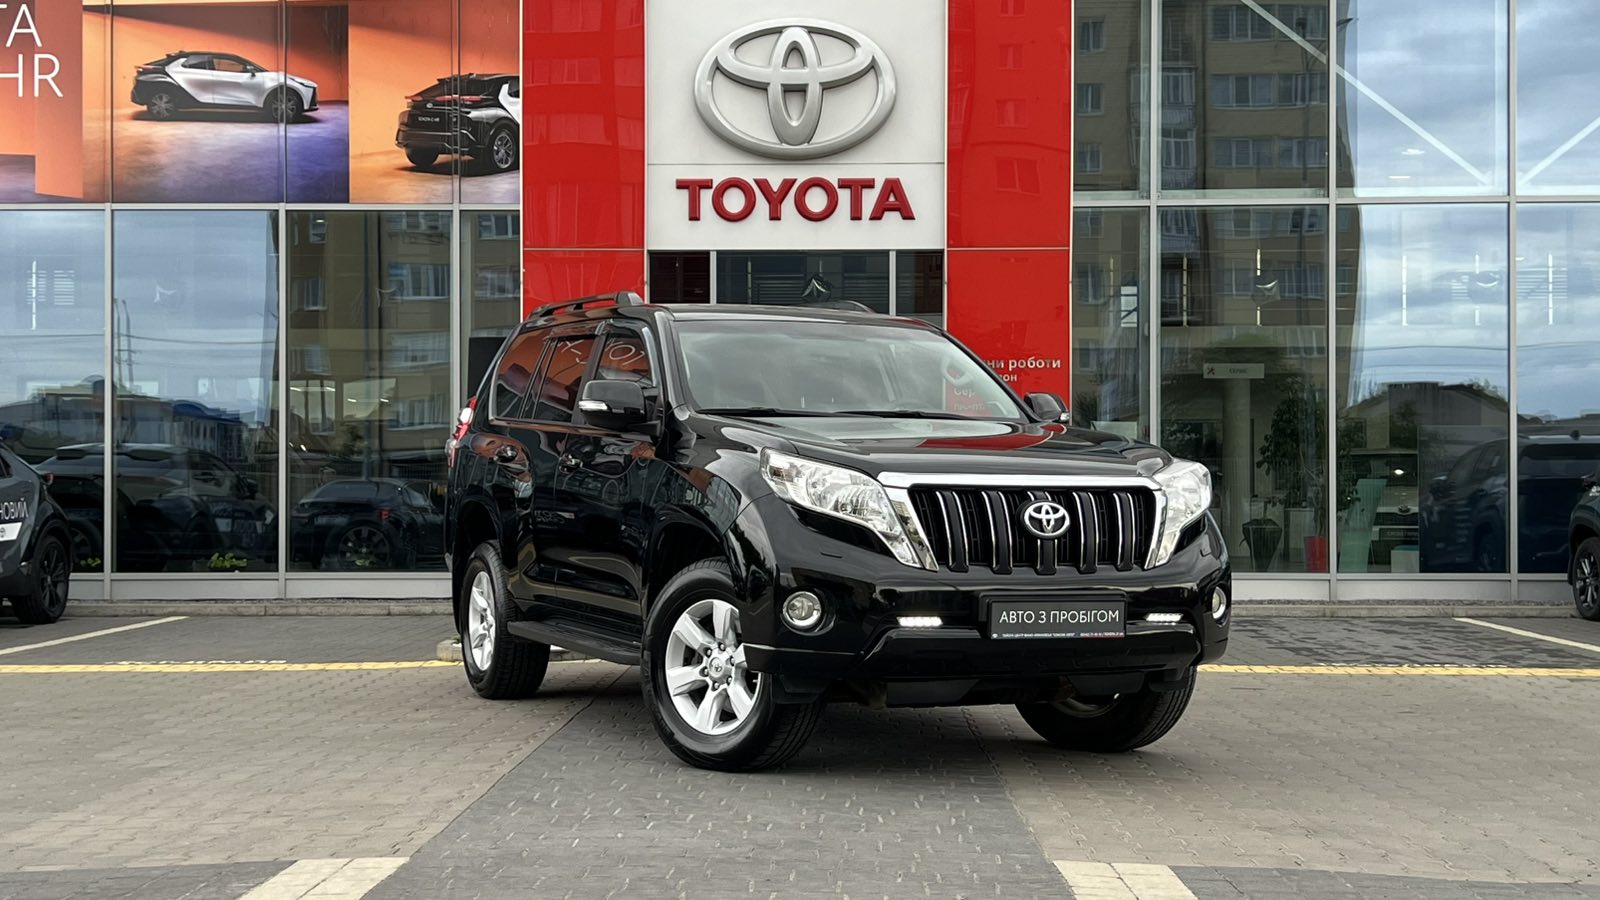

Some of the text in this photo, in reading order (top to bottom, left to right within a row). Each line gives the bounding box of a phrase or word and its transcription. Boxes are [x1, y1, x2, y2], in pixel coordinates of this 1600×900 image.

[676, 177, 916, 222] TOYOTA
[984, 356, 1061, 371] ни роботи
[999, 374, 1018, 382] он
[999, 611, 1035, 623] АВТО
[1050, 610, 1119, 623] ПРОБІГОМ
